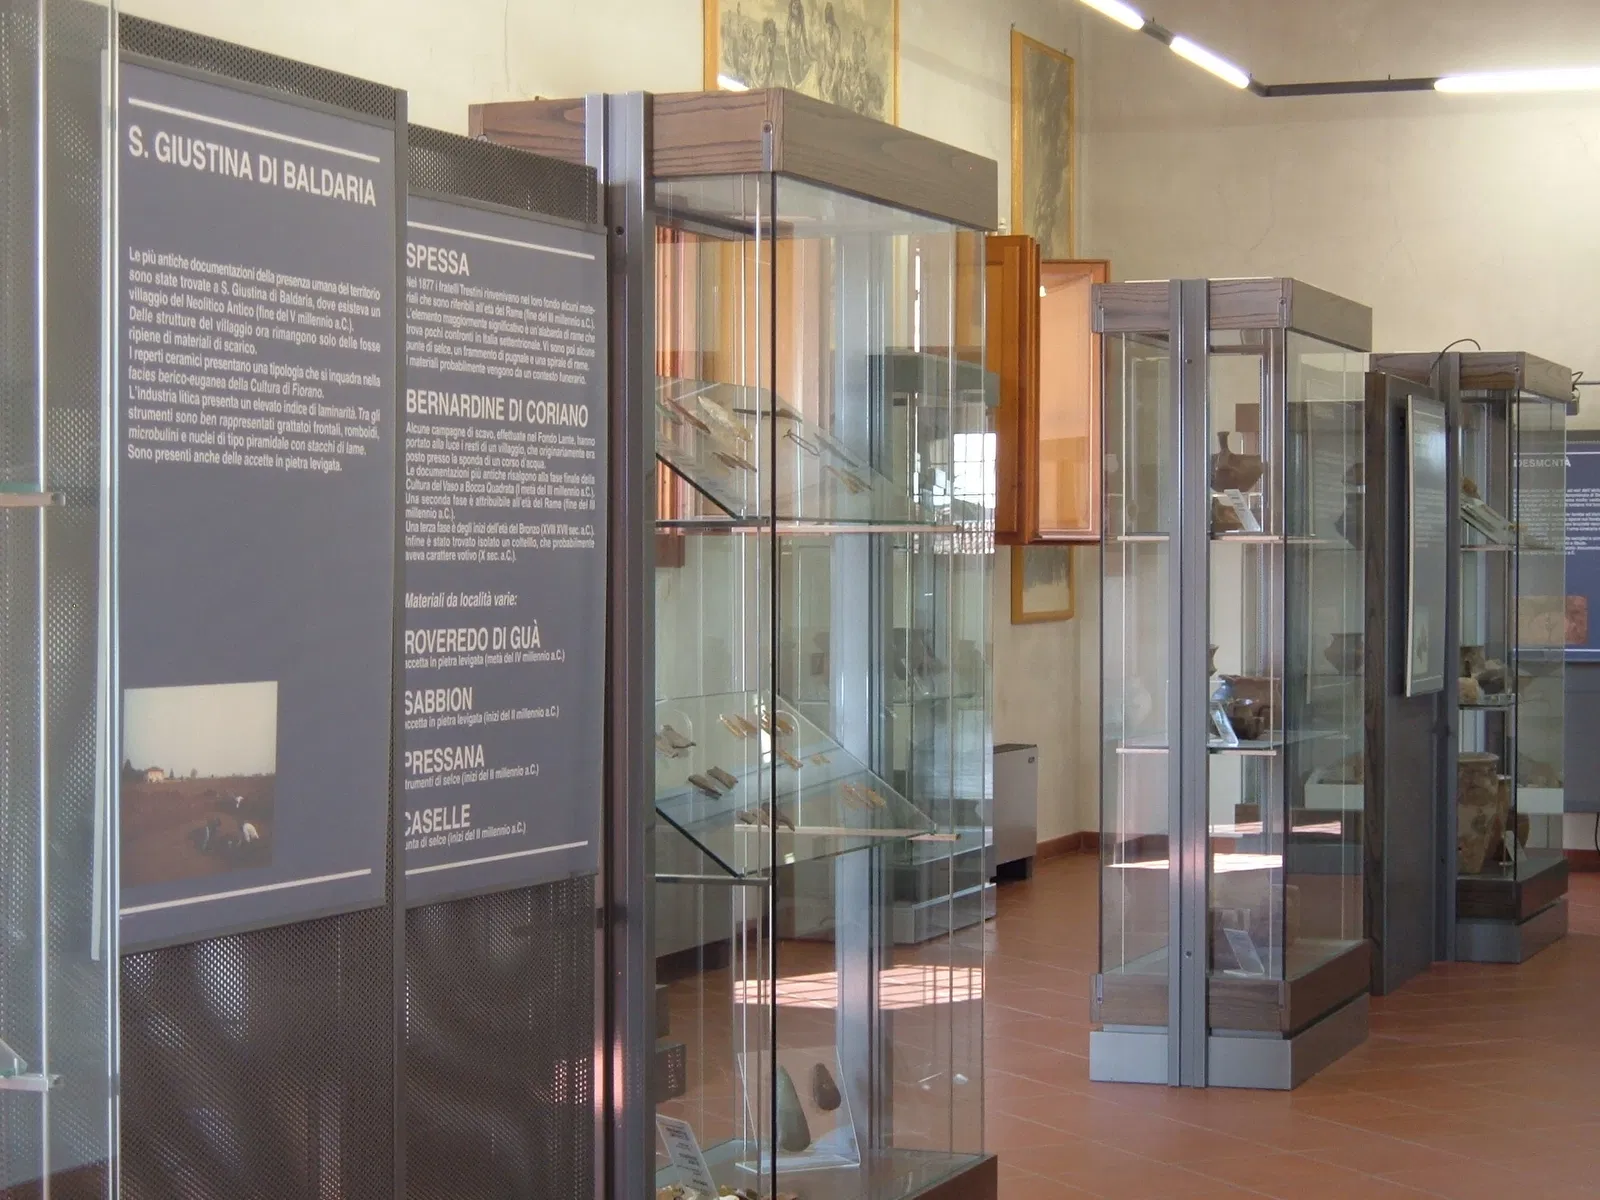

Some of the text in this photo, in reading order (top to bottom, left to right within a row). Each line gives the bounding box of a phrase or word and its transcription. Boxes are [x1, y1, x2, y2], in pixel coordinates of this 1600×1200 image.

[128, 124, 376, 206] S. GIUSTINA DI BALDARIA
[129, 246, 380, 300] Le più antiche documentazioni della presenza umana del territorio
[406, 242, 469, 277] SPESSA
[128, 286, 354, 333] villaggio del Neolitico Antico (fine del V millennio a.C.).
[129, 270, 380, 317] sono state trovate a S. Giustina di Baldaria, dove esisteva un
[128, 326, 257, 354] ripiene di materiali di scarico.
[129, 306, 380, 352] Delle strutture del villaggio ora rimangono solo delle fosse
[128, 365, 324, 398] facies berico-euganea della Cultura di Fiorano.
[134, 349, 163, 364] reperti
[165, 353, 202, 367] ceramici
[204, 357, 251, 372] presentano
[253, 363, 267, 374] una
[269, 362, 303, 380] tipologia
[305, 366, 319, 380] che
[320, 368, 327, 381] si
[329, 369, 361, 385] inquadra
[363, 373, 380, 387] nella
[128, 406, 379, 440] strumenti sono ben rappresentati grattatoi frontali, romboidi,
[406, 388, 588, 427] BERNARDINE DI CORIANO
[128, 425, 366, 455] microbulini e nuclei di tipo piramidale con stacchi di lame.
[127, 444, 342, 473] Sono presenti anche delle accette in pietra levigata.
[404, 590, 518, 608] Materiali da località varie:
[404, 618, 540, 654] ROVEREDO DI GUÀ
[404, 685, 472, 715] SABBION
